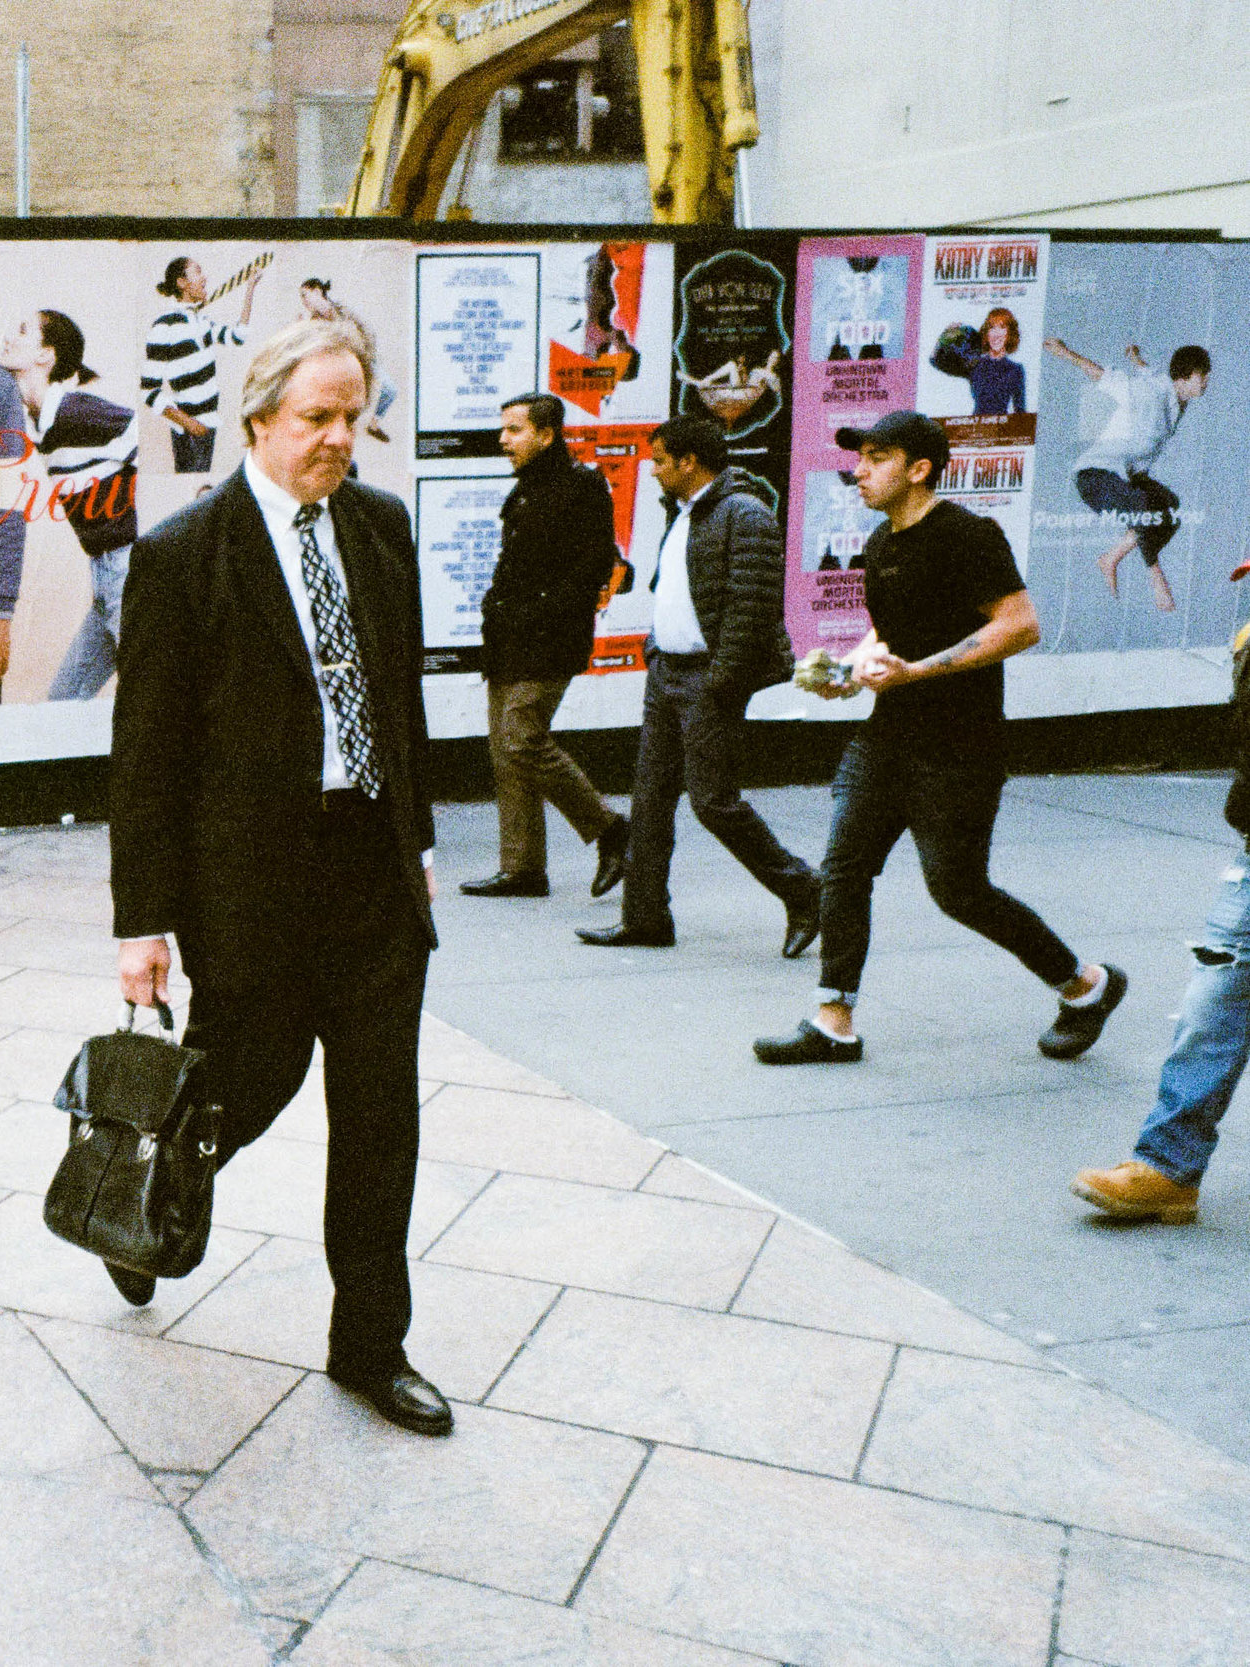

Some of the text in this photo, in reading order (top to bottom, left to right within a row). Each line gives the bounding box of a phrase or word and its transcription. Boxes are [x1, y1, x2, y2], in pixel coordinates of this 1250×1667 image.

[934, 245, 1038, 279] KATHY GRIFFIN
[838, 272, 884, 298] SEX
[825, 320, 890, 345] FOOD
[972, 456, 1024, 488] GRIFFIN
[1100, 508, 1164, 527] Moves
[816, 530, 866, 557] FOO
